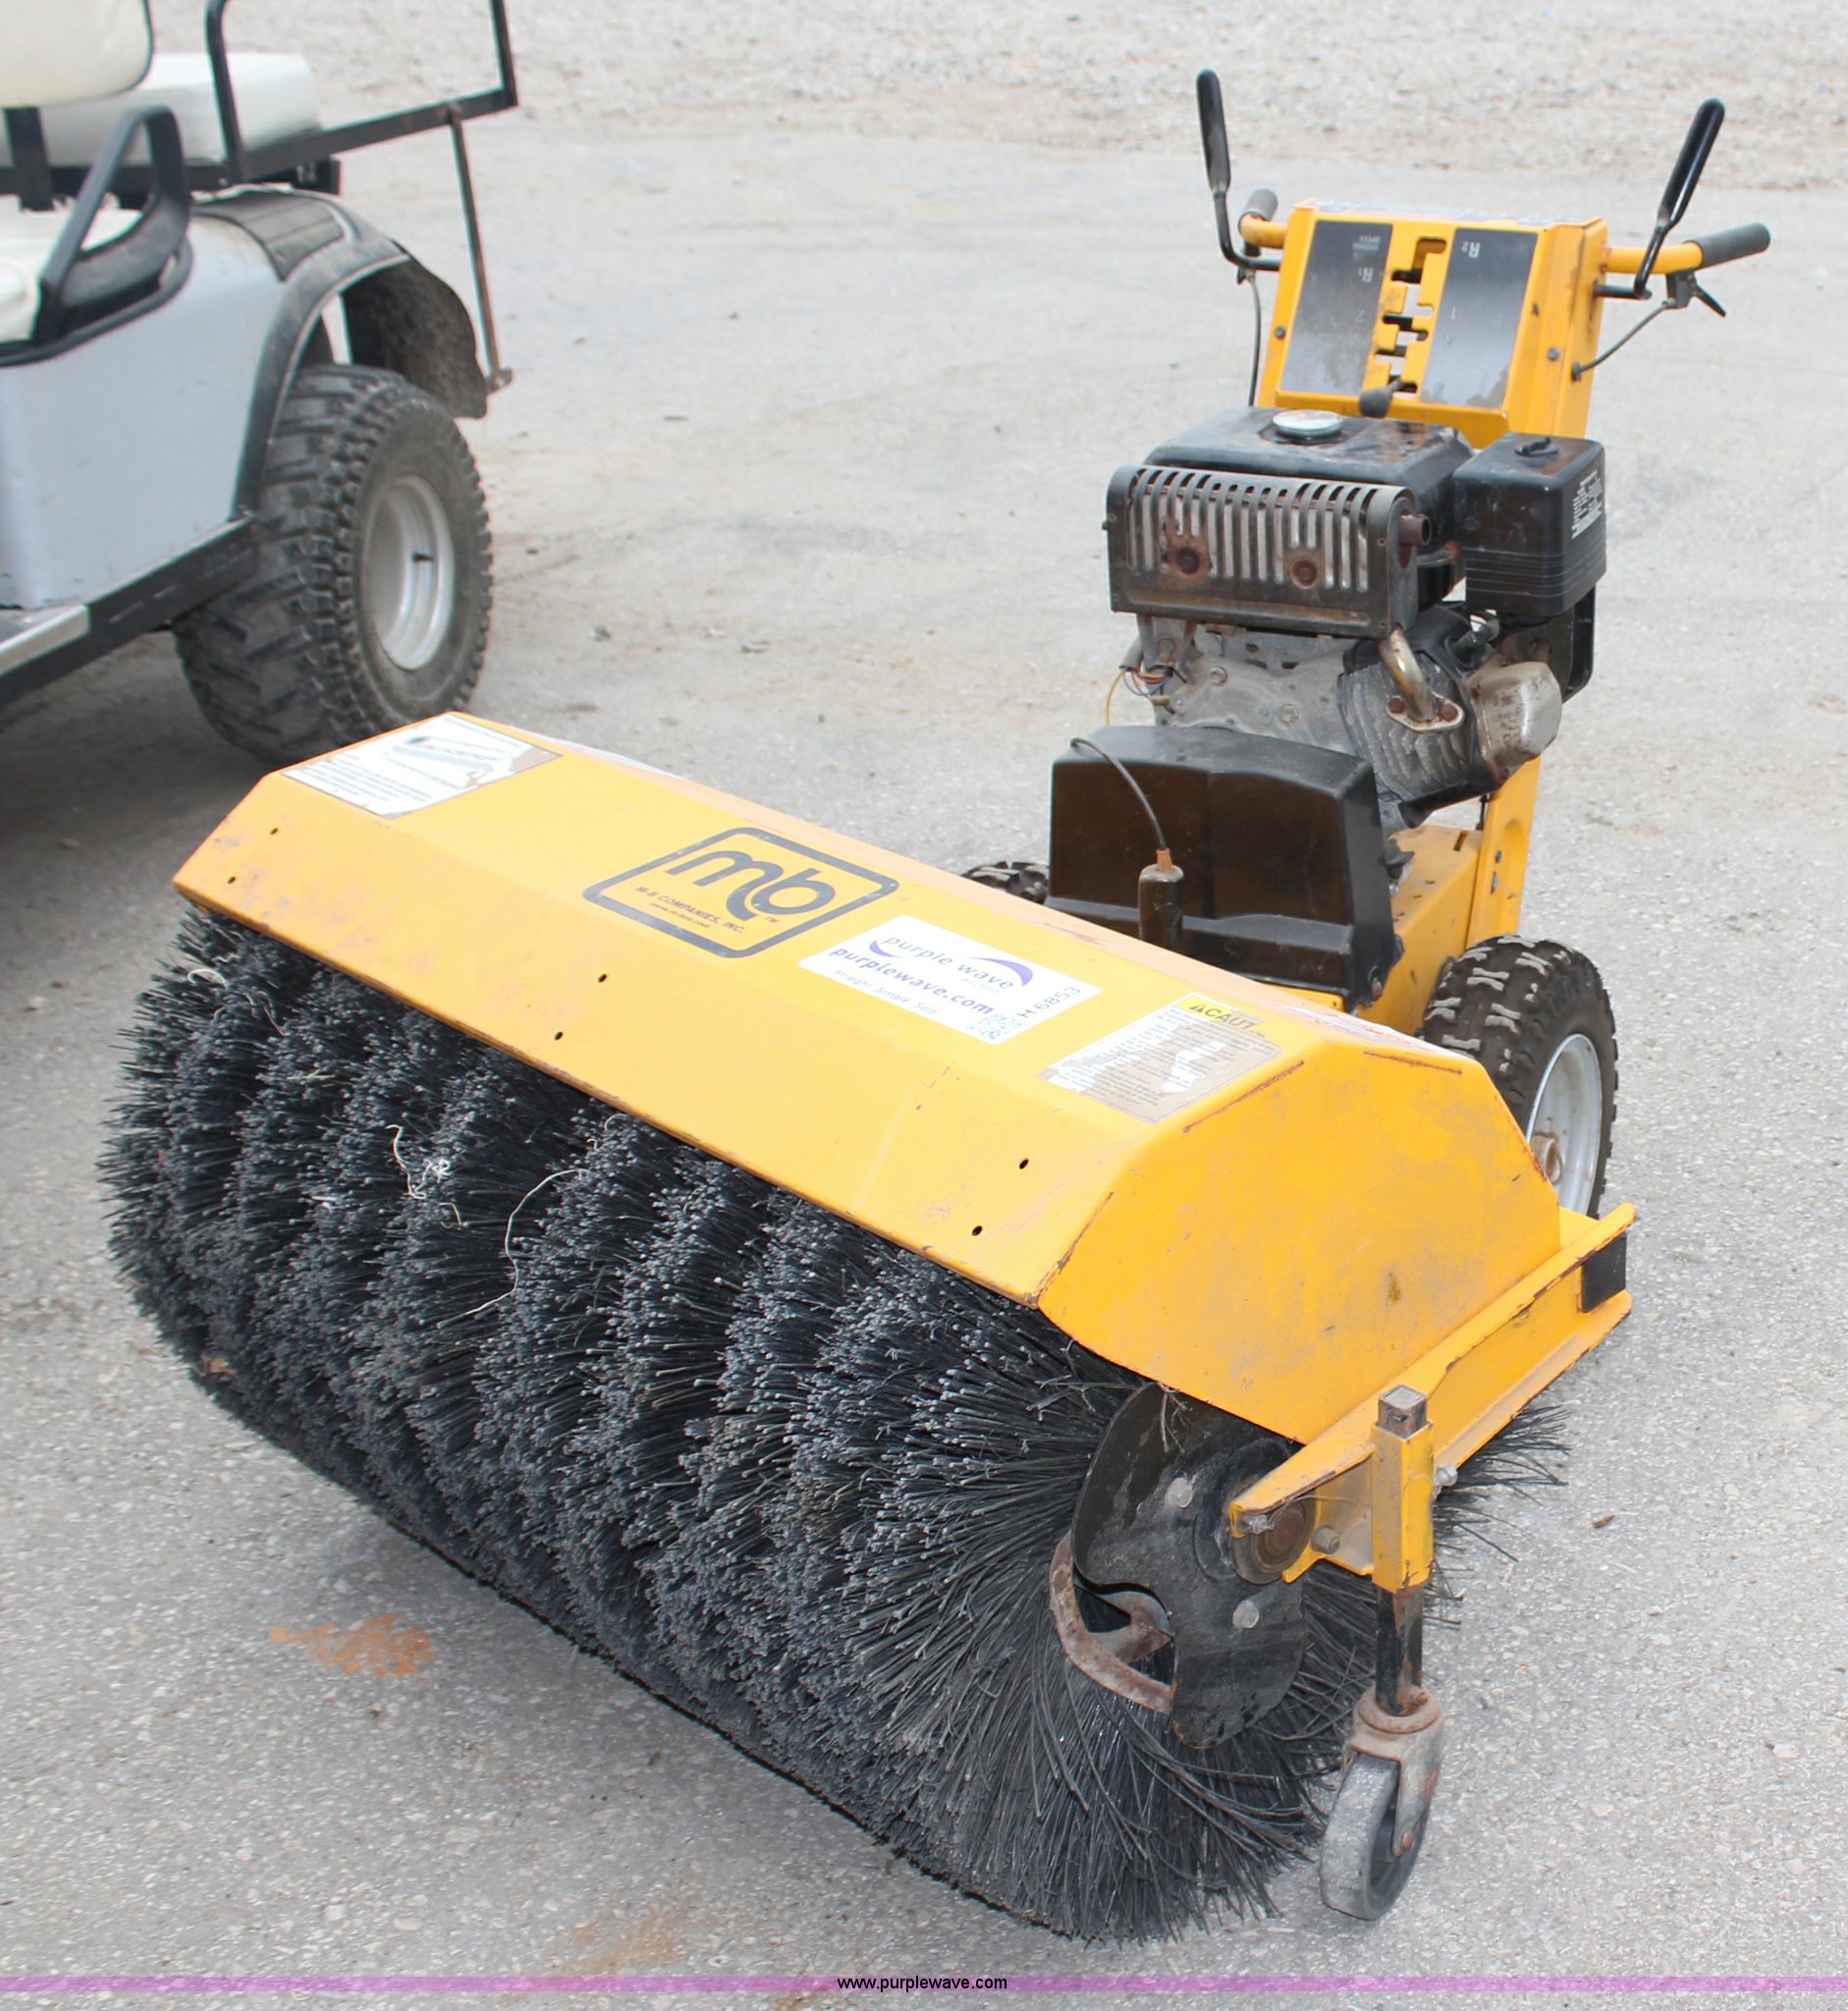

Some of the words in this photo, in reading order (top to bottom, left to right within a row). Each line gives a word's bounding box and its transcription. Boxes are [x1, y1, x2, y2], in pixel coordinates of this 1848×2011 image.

[664, 849, 836, 922] mb
[828, 948, 995, 1015] purplewave.com
[881, 936, 953, 965] purple
[957, 963, 1014, 990] wave
[1015, 986, 1081, 1019] H6853
